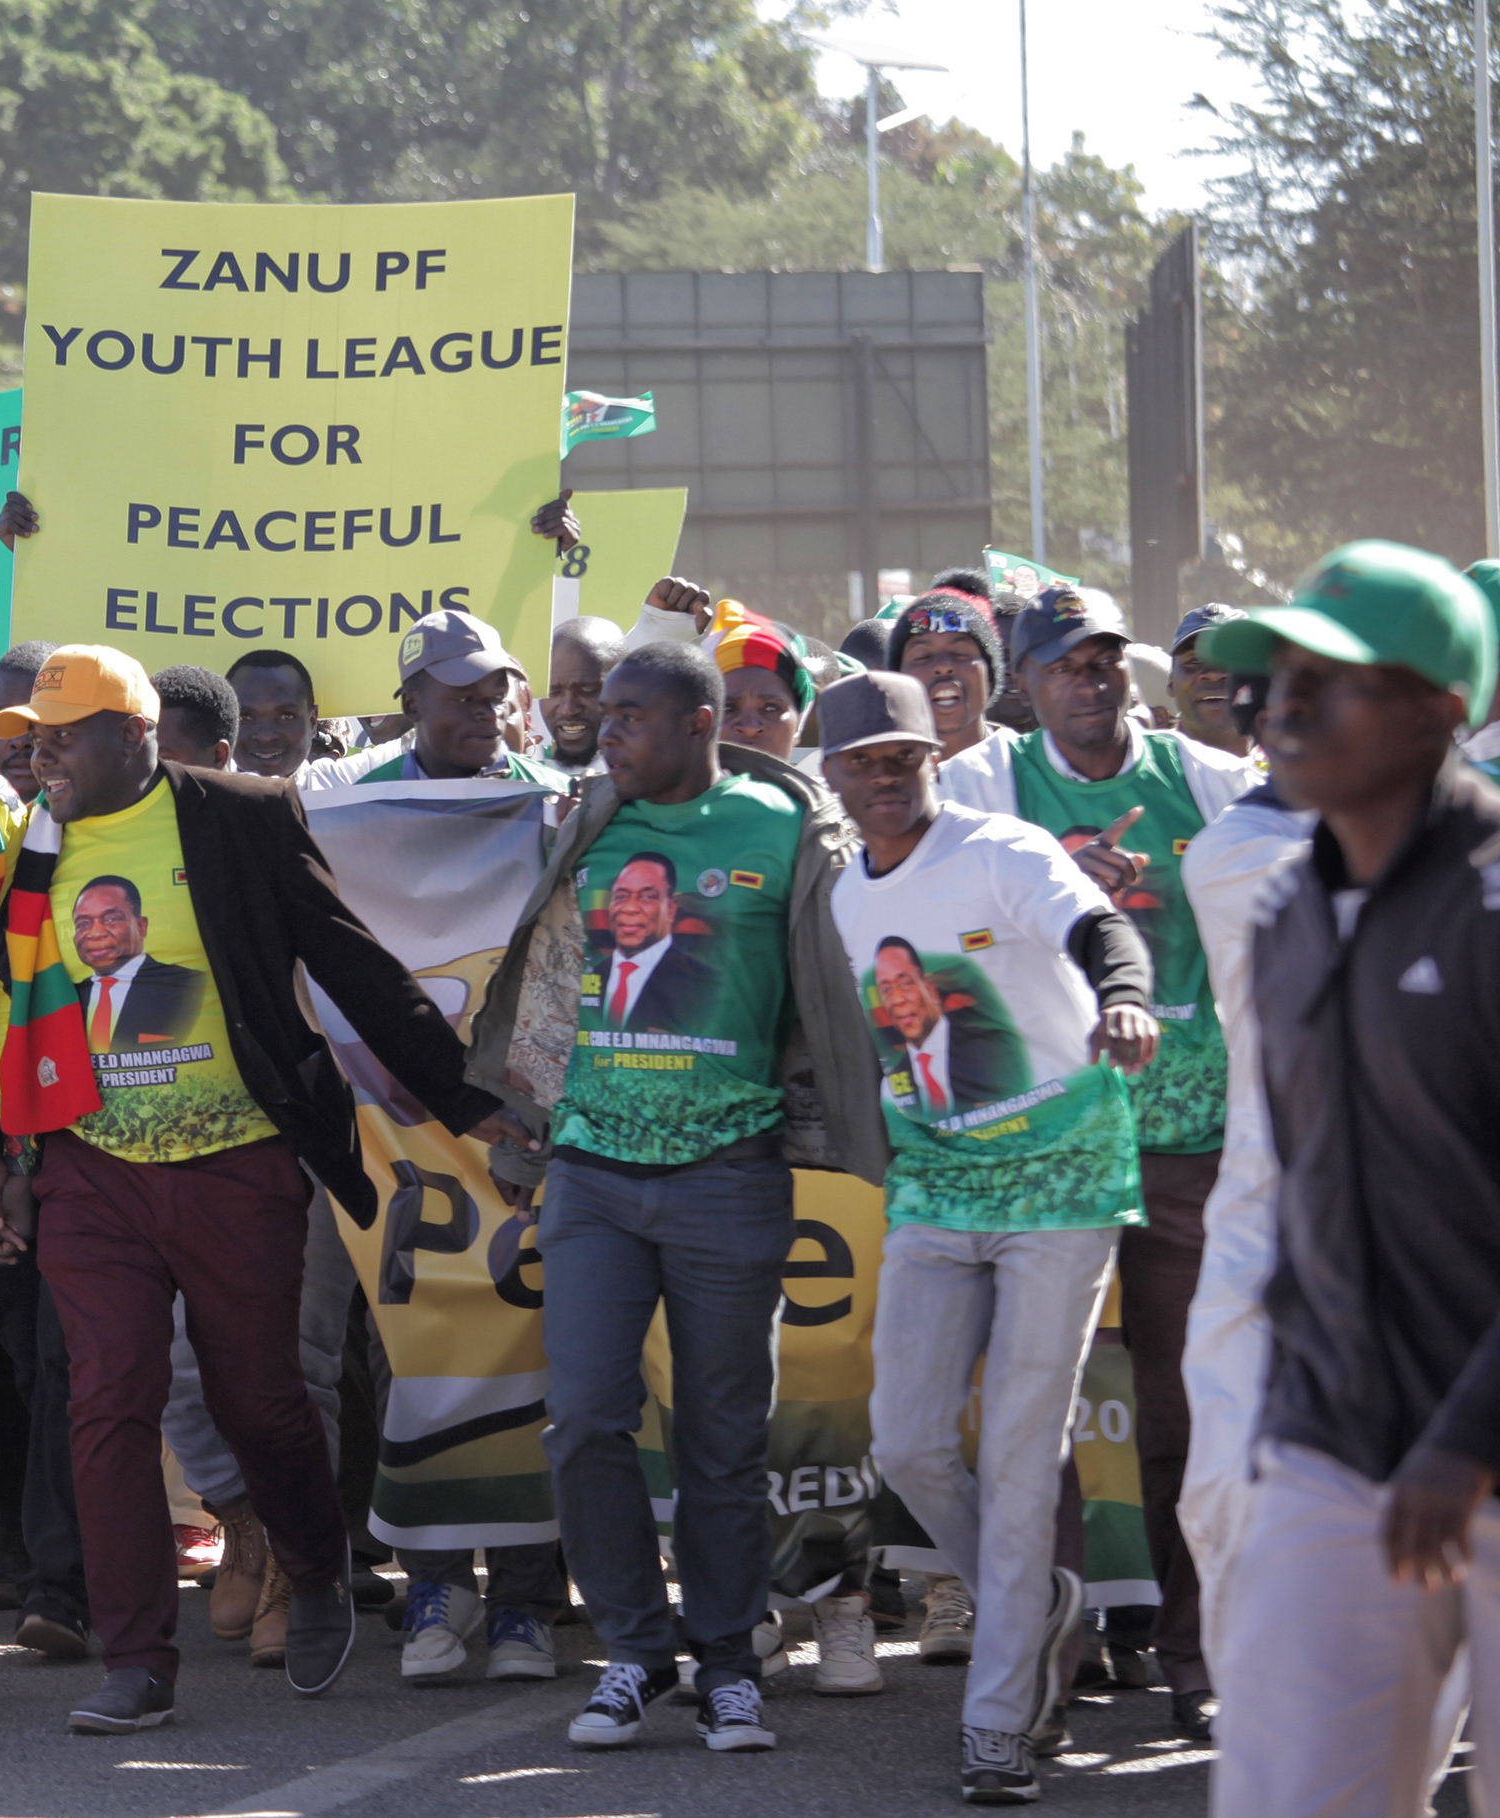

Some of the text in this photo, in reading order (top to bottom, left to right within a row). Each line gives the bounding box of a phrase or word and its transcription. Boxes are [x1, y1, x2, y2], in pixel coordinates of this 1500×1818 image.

[159, 248, 448, 295] ZANU PF
[41, 324, 564, 381] YOUTH LEAGUE
[233, 424, 363, 465] FOR
[126, 502, 462, 553] PEACEFUL
[100, 1054, 118, 1068] E.D
[121, 1044, 213, 1068] MNANGAGWA
[635, 1033, 737, 1056] MNANGAGWA
[102, 1068, 176, 1087] PRESIDENT
[614, 1053, 695, 1070] PRESIDENT
